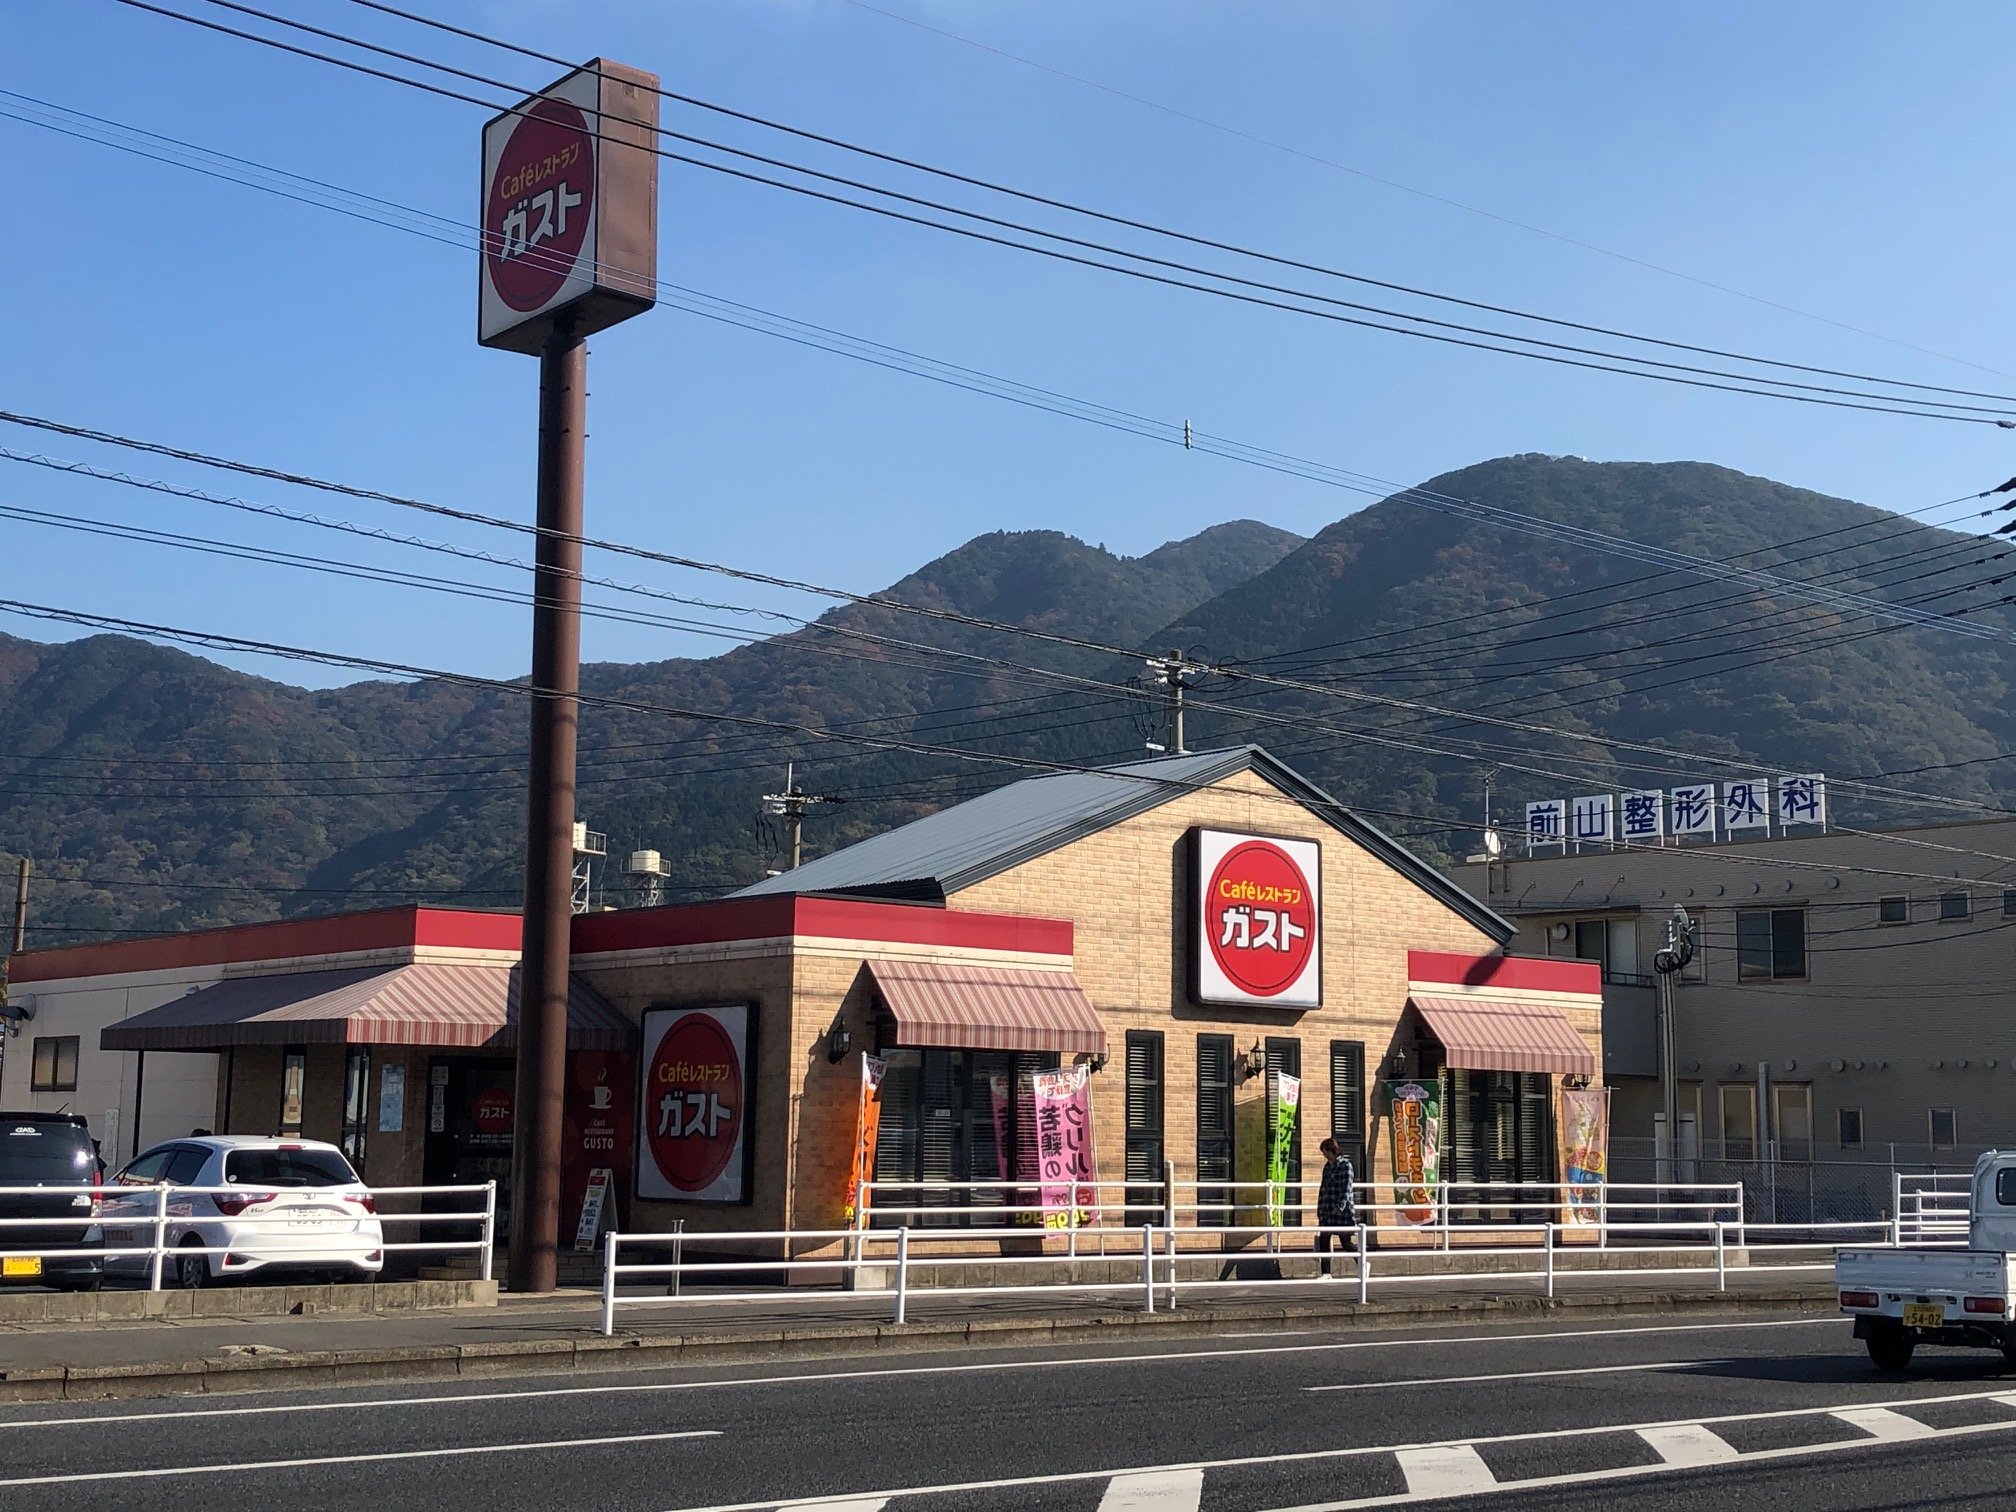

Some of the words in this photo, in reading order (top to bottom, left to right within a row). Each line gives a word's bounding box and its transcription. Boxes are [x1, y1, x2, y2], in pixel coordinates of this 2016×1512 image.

[501, 142, 580, 200] Caféレストラン
[501, 181, 582, 263] ガスト
[1528, 777, 1822, 843] 前山整形外科
[1219, 879, 1301, 905] Caféレストラン
[1221, 905, 1305, 952] ガスト
[659, 1060, 730, 1082] Caféレストラン
[479, 1106, 510, 1119] ガスト
[658, 1091, 731, 1137] ガスト
[583, 1137, 614, 1149] GUSTO
[1911, 1312, 1941, 1326] 54-02
